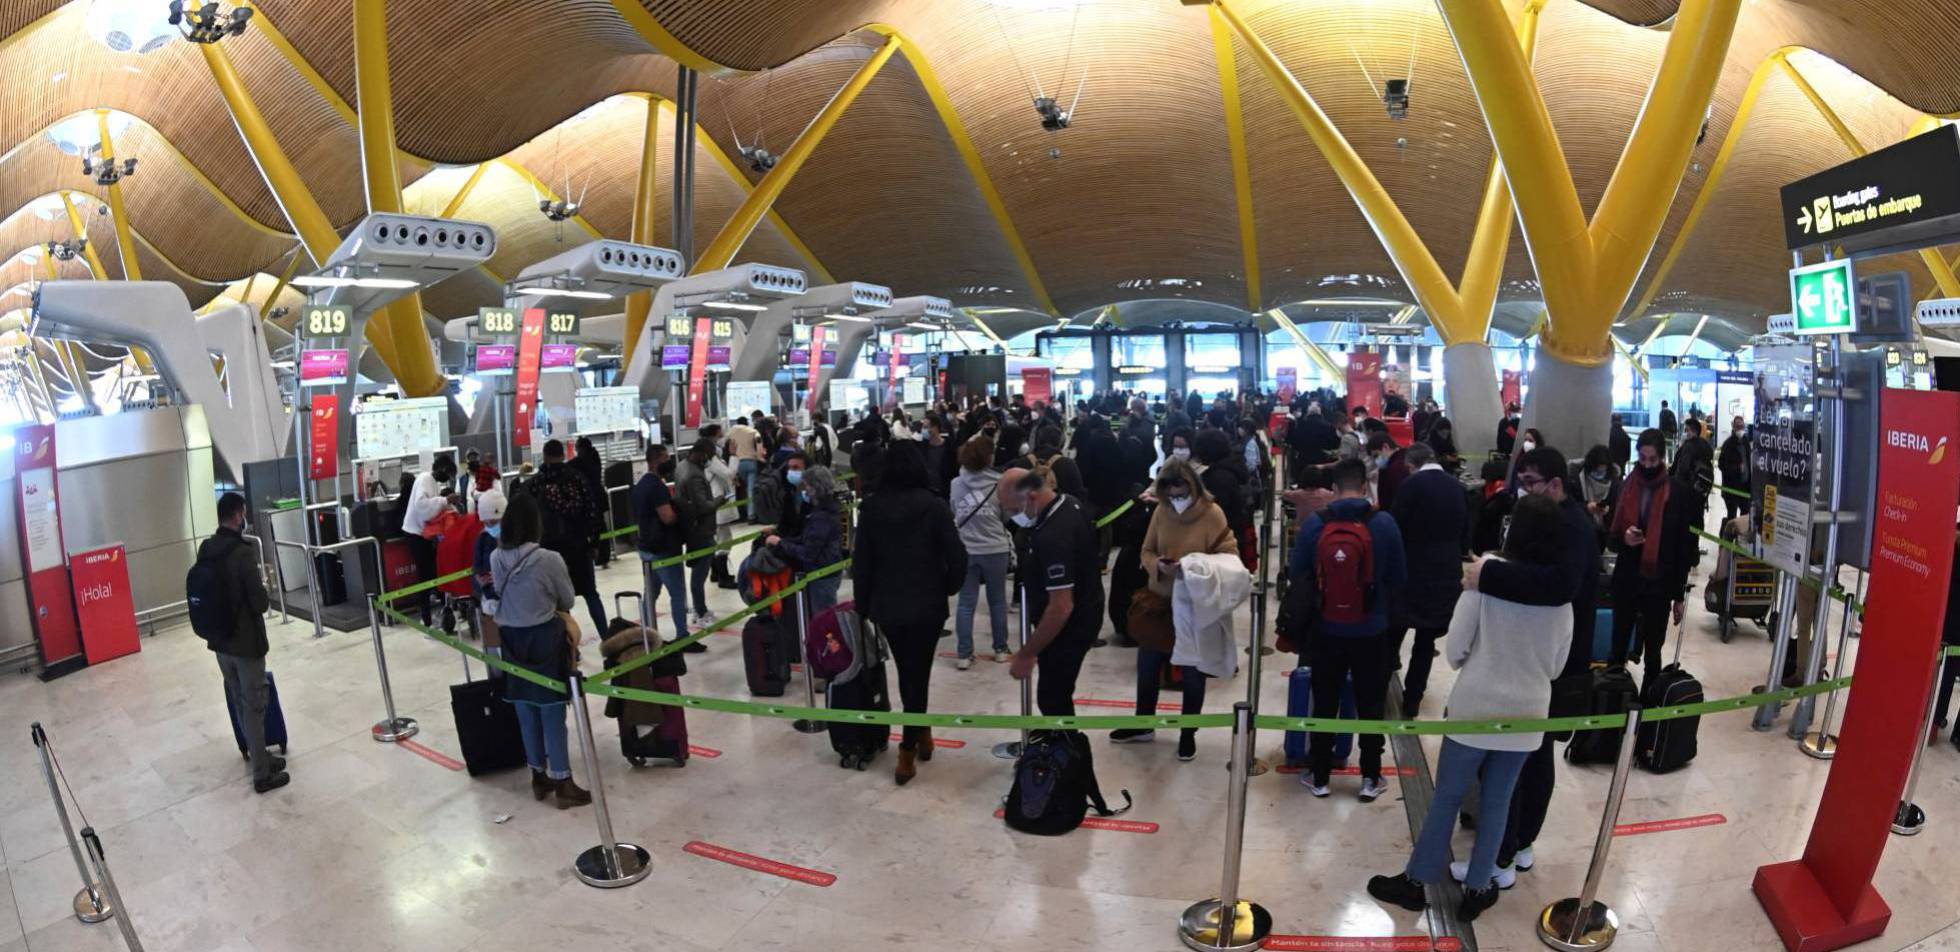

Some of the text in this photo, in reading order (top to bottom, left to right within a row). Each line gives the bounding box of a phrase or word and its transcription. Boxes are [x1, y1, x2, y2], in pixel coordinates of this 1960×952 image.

[1834, 194, 1922, 227] Puertas de embarque
[309, 309, 346, 334] 819
[484, 311, 514, 332] 818
[550, 313, 575, 332] 817
[669, 318, 690, 336] 816
[713, 320, 732, 337] 815
[1352, 362, 1363, 371] IB
[20, 441, 33, 455] IB
[1760, 432, 1811, 456] cancelado
[1887, 429, 1929, 452] IBERIA
[1759, 452, 1807, 481] el vuelo?
[85, 552, 110, 564] IBERIA
[81, 582, 113, 607] ¡Hola!
